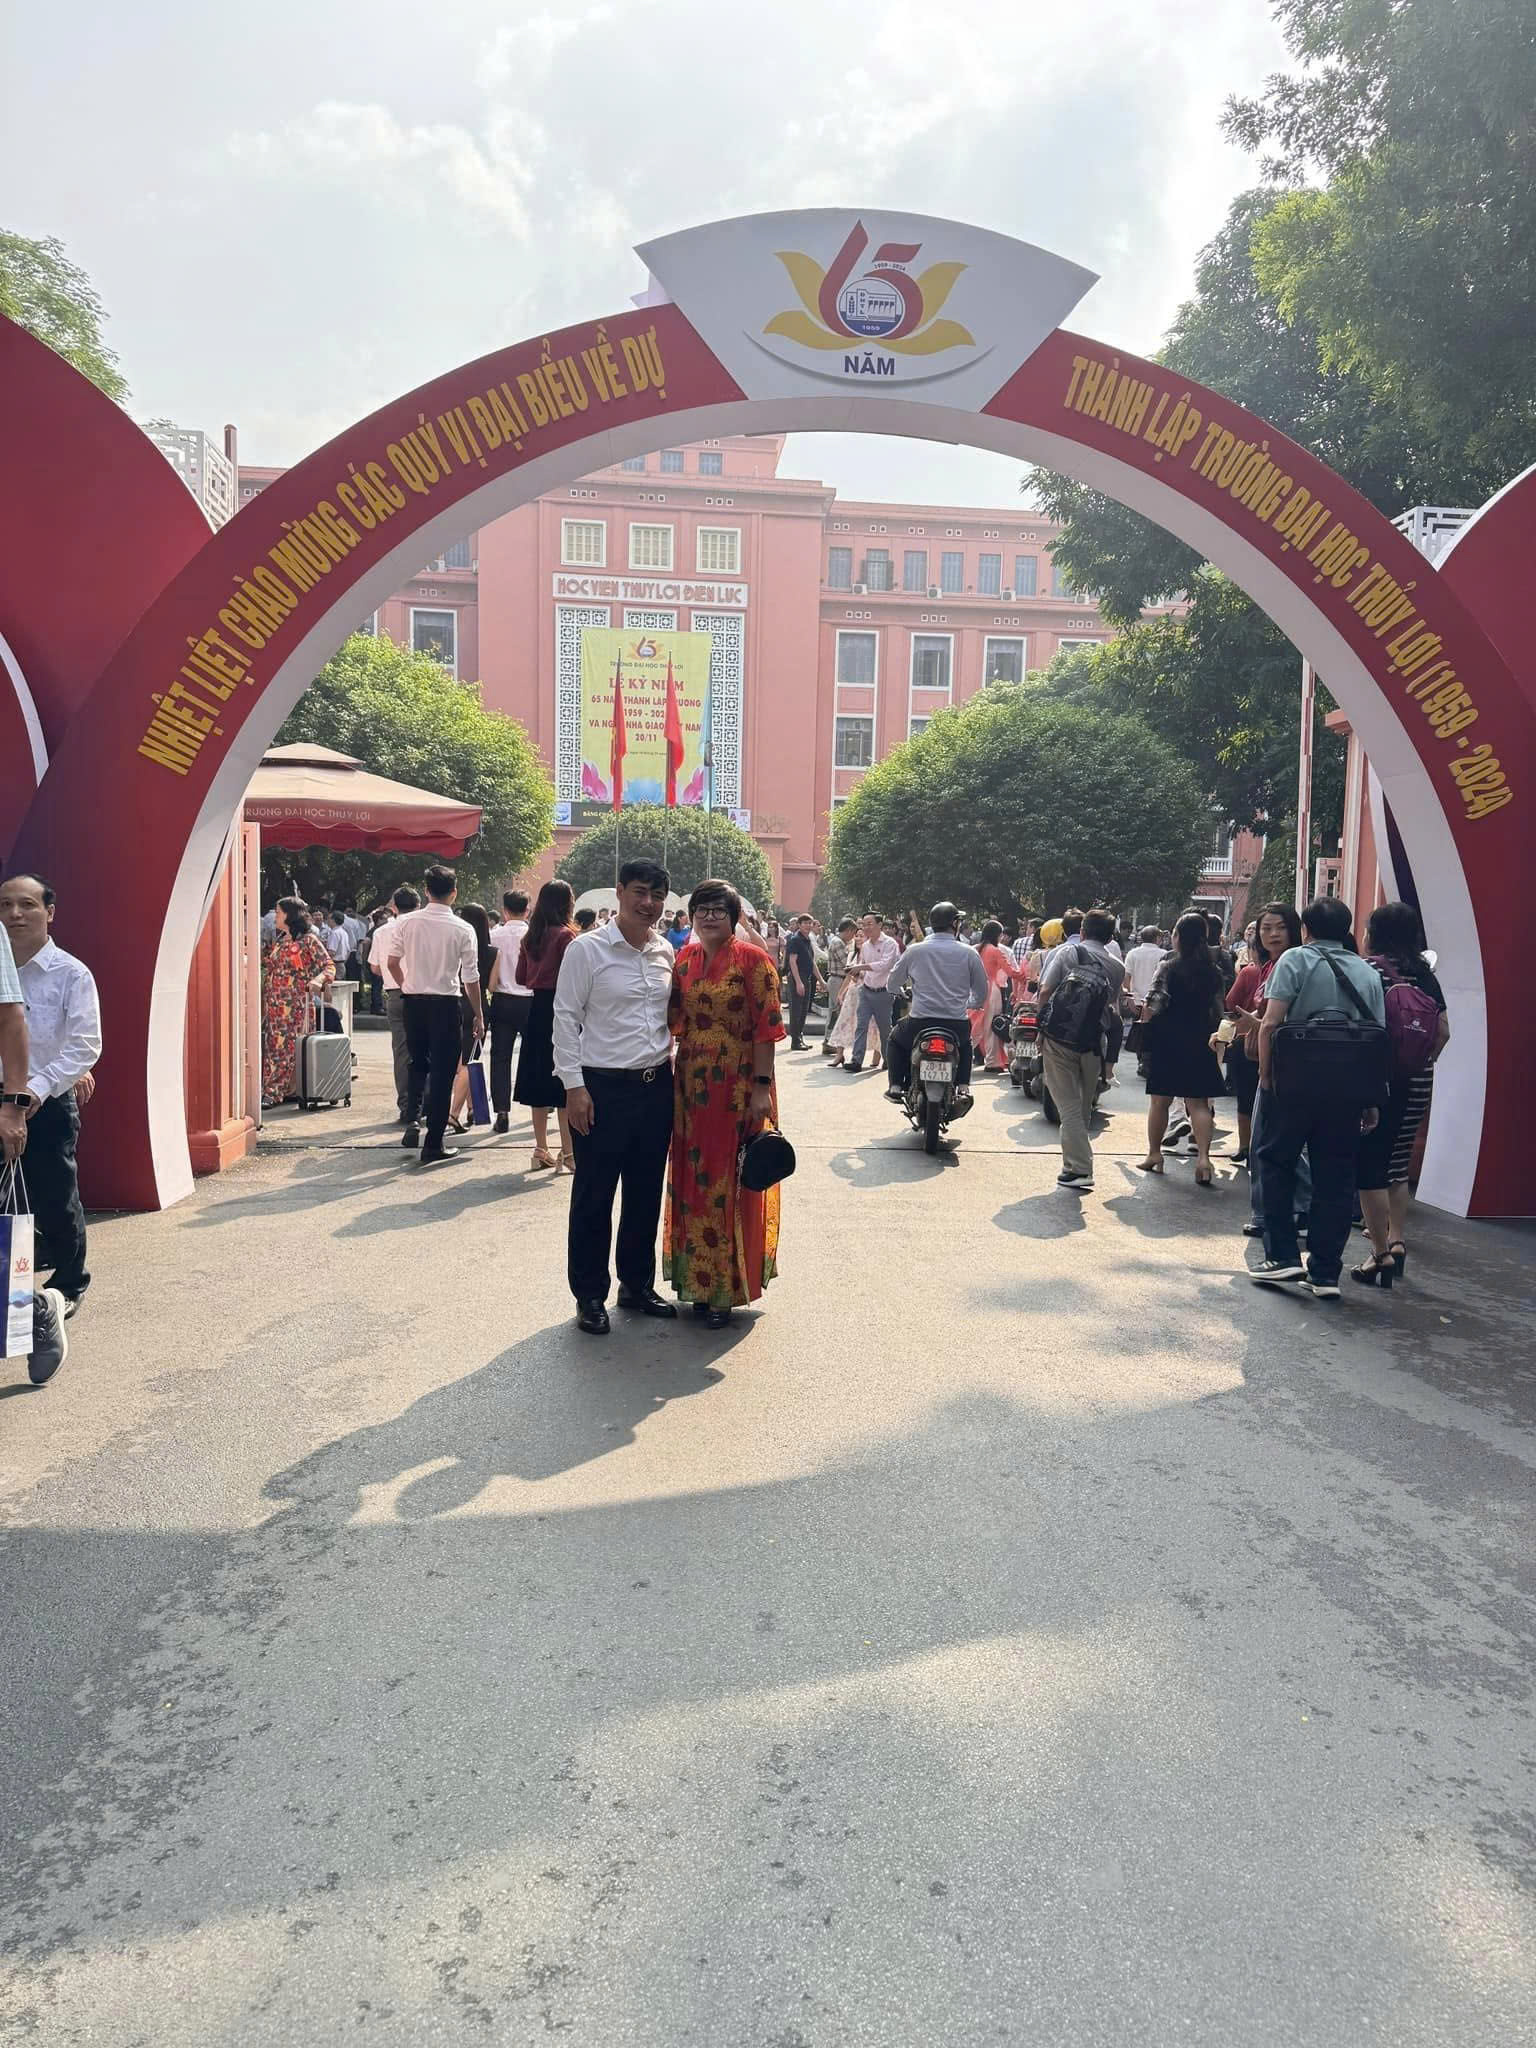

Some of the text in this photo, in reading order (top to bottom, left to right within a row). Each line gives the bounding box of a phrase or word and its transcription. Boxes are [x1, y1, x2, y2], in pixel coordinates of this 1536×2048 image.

[819, 218, 923, 340] 65
[844, 351, 895, 376] NĂM
[1063, 355, 1154, 437] THÀNH
[1143, 391, 1202, 463] LẬP
[1190, 421, 1293, 522] TRƯỜNG
[137, 324, 667, 776] NHIỆT LIỆT CHÀO MỪNG CÁC QUÝ VỊ ĐẠI BIỂU VỀ DỰ
[1272, 486, 1332, 552] ĐẠI
[1306, 522, 1370, 588] HỌC
[1345, 562, 1417, 639] THỦY
[1385, 619, 1443, 677] LỢI
[591, 695, 601, 703] 65
[624, 708, 643, 718] 1959
[651, 709, 665, 718] 202
[651, 679, 685, 692] NIM
[1405, 660, 1479, 739] (1959
